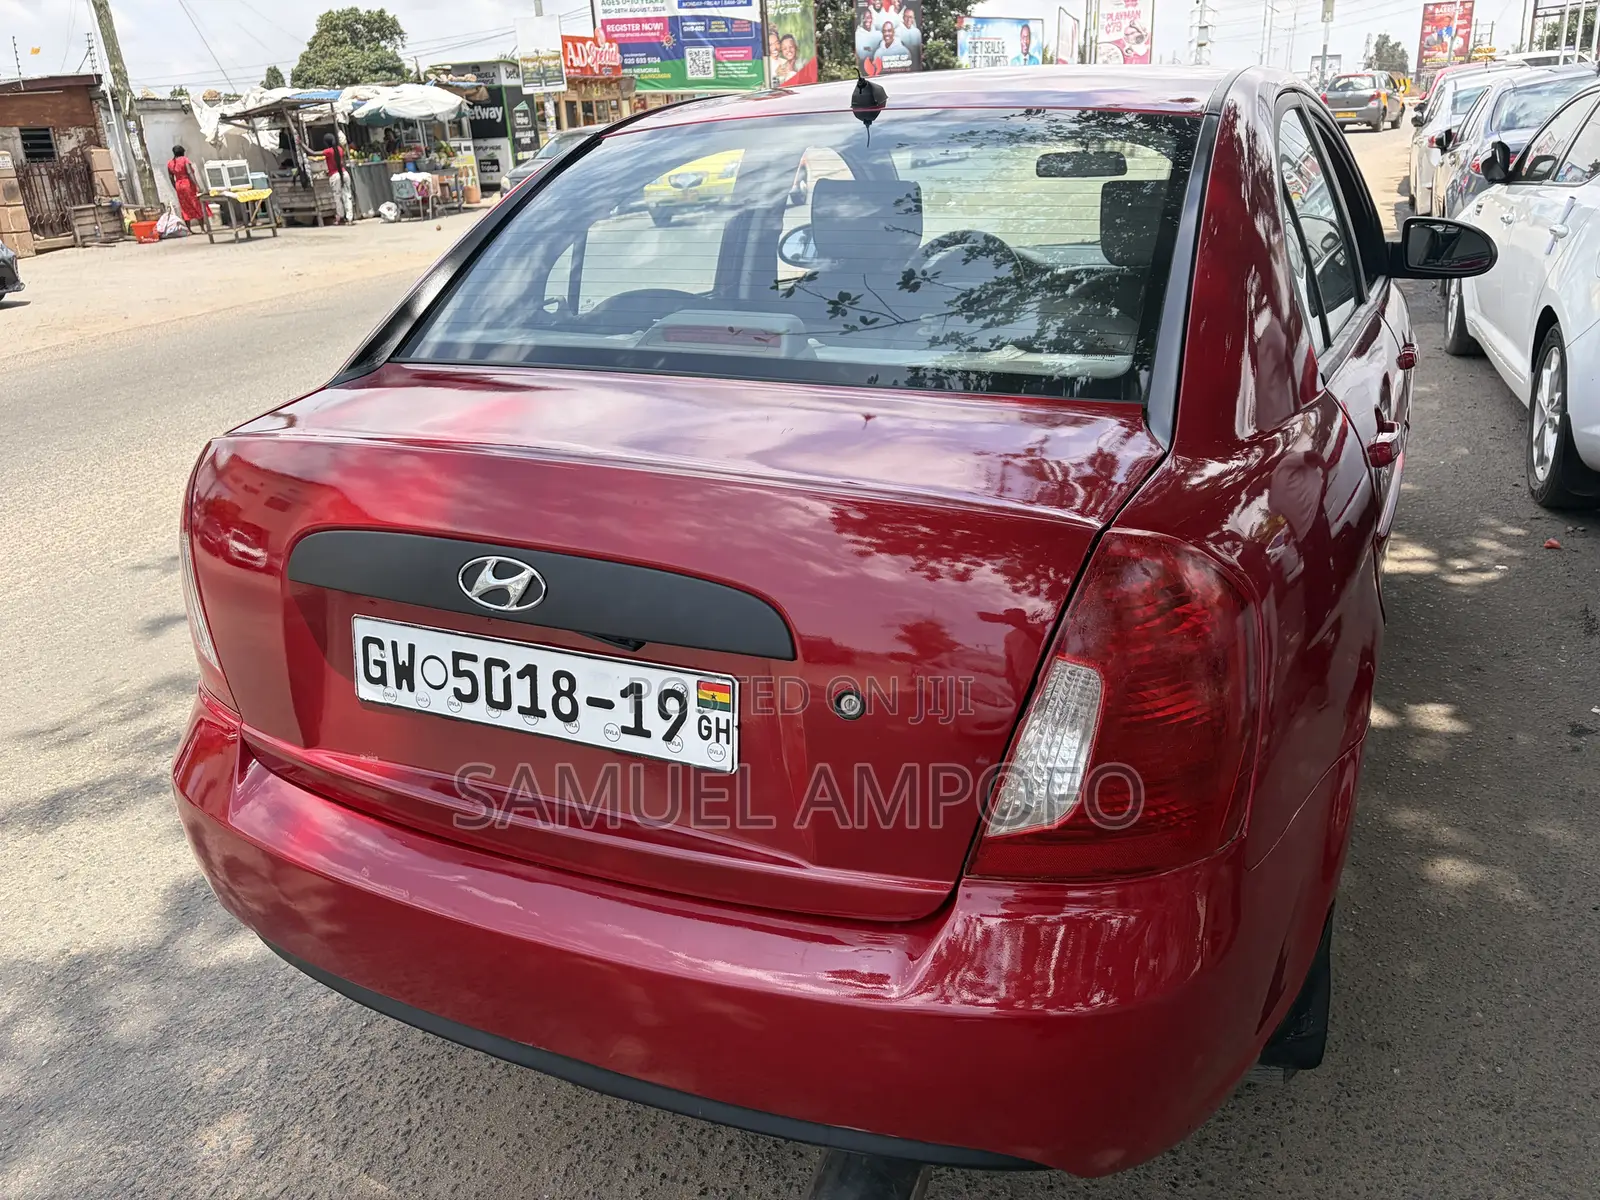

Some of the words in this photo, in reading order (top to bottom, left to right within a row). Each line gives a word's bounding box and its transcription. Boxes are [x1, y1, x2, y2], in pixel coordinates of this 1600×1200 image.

[606, 24, 641, 32] REGISTER
[642, 23, 664, 31] NOW!
[968, 41, 979, 54] THE
[985, 41, 1000, 54] SEALS
[467, 105, 503, 123] etway
[362, 635, 416, 693] GW
[451, 650, 688, 742] 5018-19
[697, 714, 731, 745] GH
